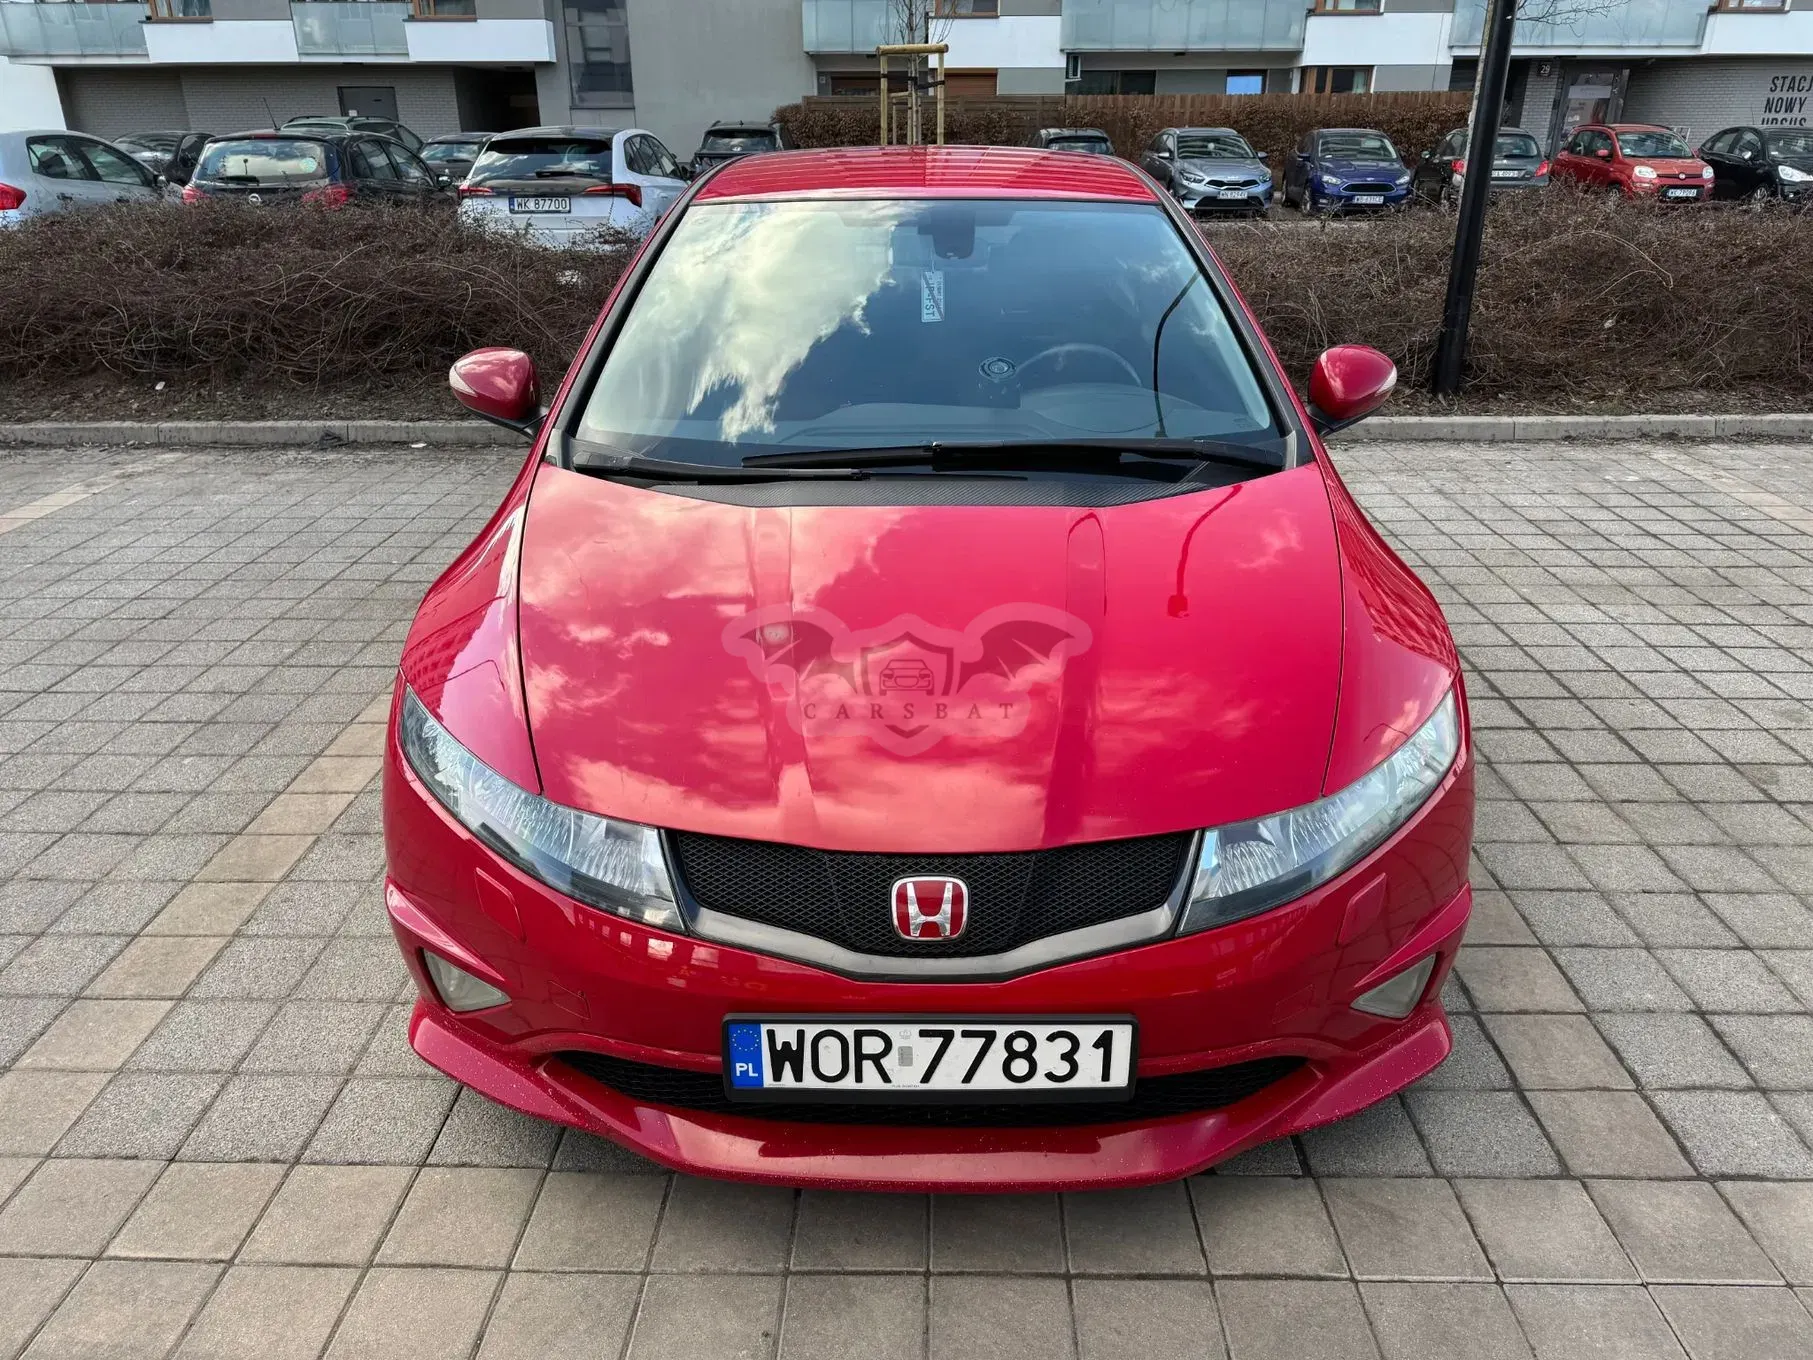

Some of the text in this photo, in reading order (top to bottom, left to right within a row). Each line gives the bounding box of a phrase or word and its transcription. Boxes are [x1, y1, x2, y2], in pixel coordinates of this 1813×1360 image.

[1764, 96, 1807, 113] NOWY
[517, 198, 567, 209] WK 87700
[735, 1029, 1114, 1084] PL WOR 77831
